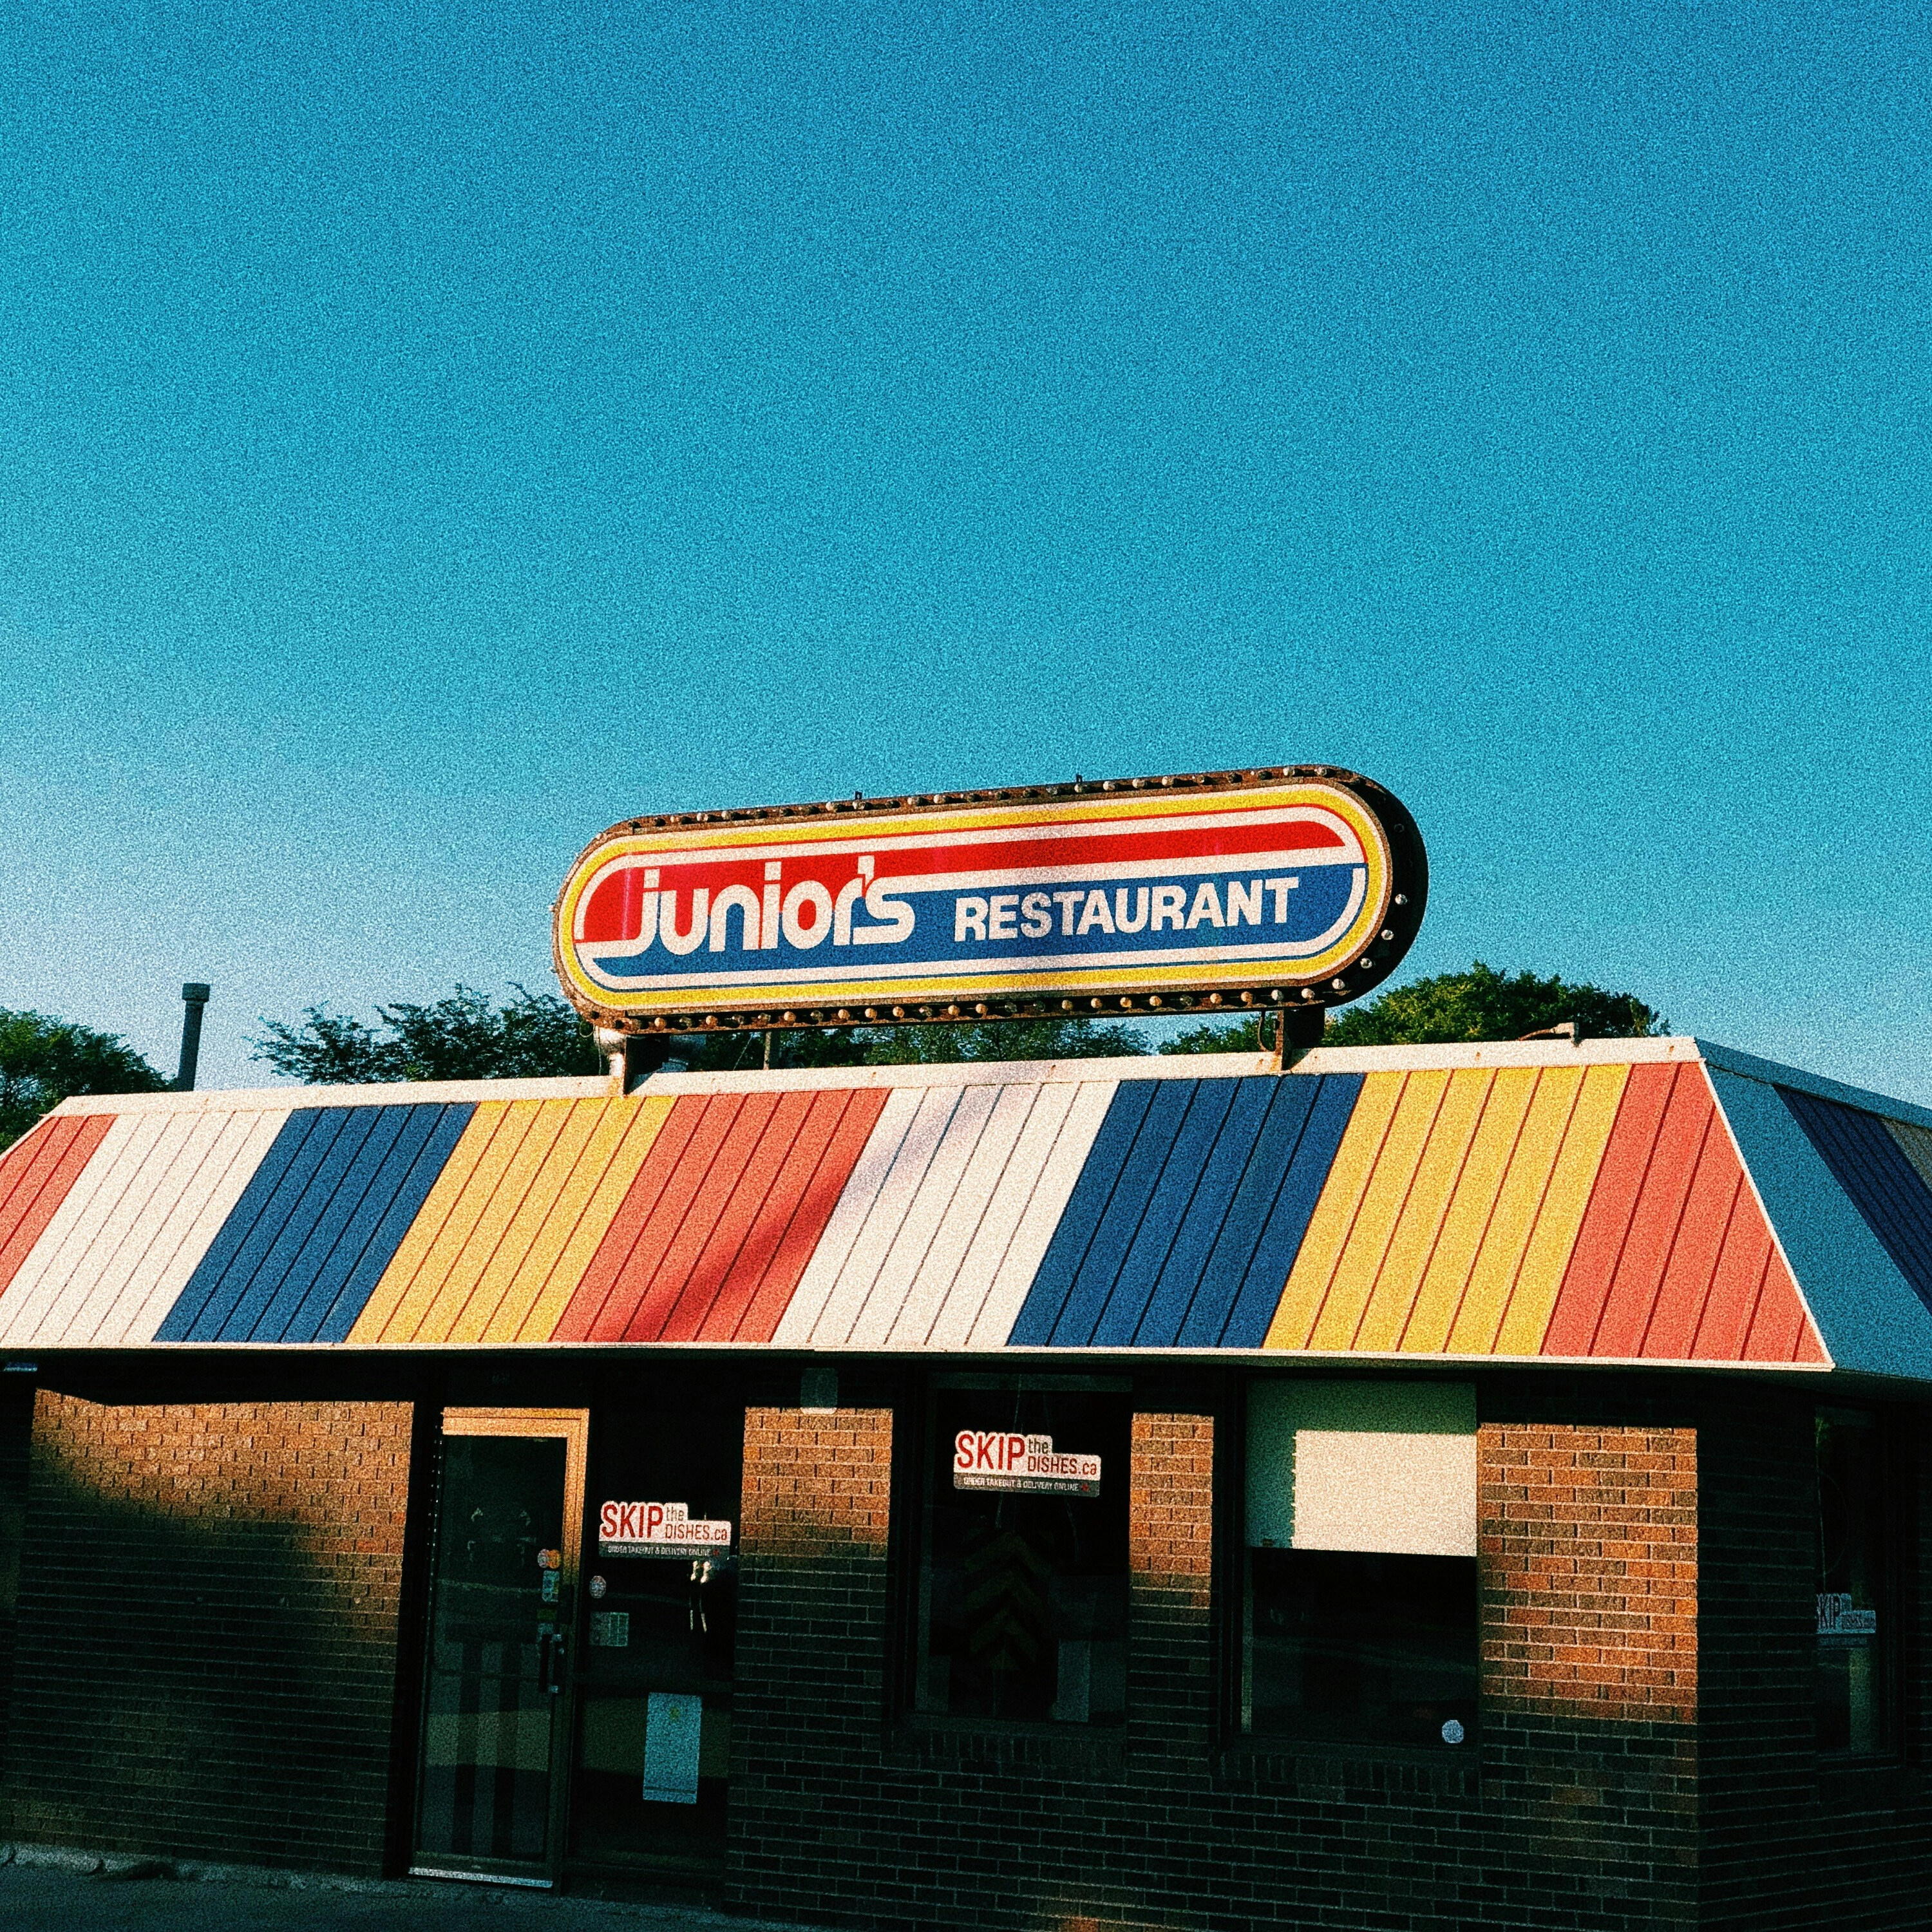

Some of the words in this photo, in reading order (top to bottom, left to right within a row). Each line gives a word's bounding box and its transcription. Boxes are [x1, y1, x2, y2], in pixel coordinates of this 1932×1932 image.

[954, 877, 1299, 942] RESTAURANT
[957, 1434, 1025, 1470] SKIP
[1028, 1438, 1049, 1454] the
[1027, 1456, 1097, 1475] DISHES.ca
[986, 1479, 1015, 1487] TAKEOUT
[1023, 1481, 1052, 1490] DELIVERY
[1054, 1482, 1079, 1492] ONLINE
[601, 1504, 663, 1539] SKIP
[666, 1507, 684, 1521] the
[665, 1524, 728, 1541] DISHES.ca
[1817, 1594, 1841, 1631] KIP
